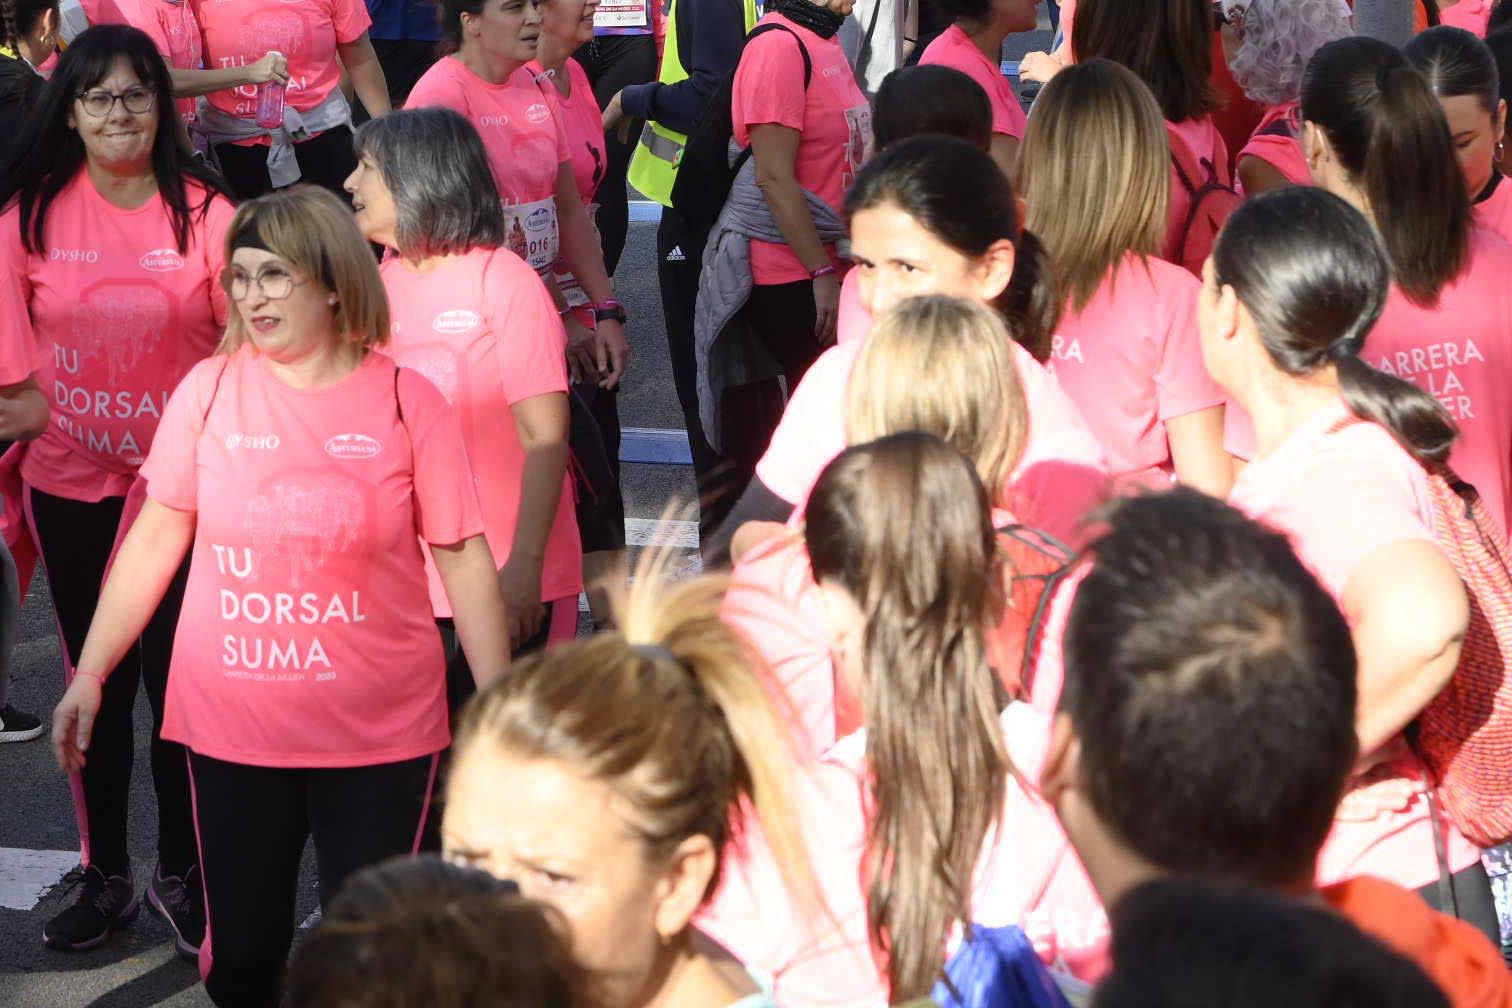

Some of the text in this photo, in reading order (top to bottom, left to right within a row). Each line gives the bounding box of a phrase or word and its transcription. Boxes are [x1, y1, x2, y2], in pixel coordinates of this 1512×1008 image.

[50, 249, 98, 264] OYSHO
[529, 237, 549, 255] 016
[53, 343, 79, 374] TU
[1366, 338, 1485, 377] ARRERA
[1427, 369, 1465, 396] LA
[226, 433, 281, 451] OYSHO
[328, 441, 379, 456] ASTURIANA
[212, 543, 253, 579] TU
[220, 589, 366, 626] DORSAL
[222, 634, 332, 670] SUMA
